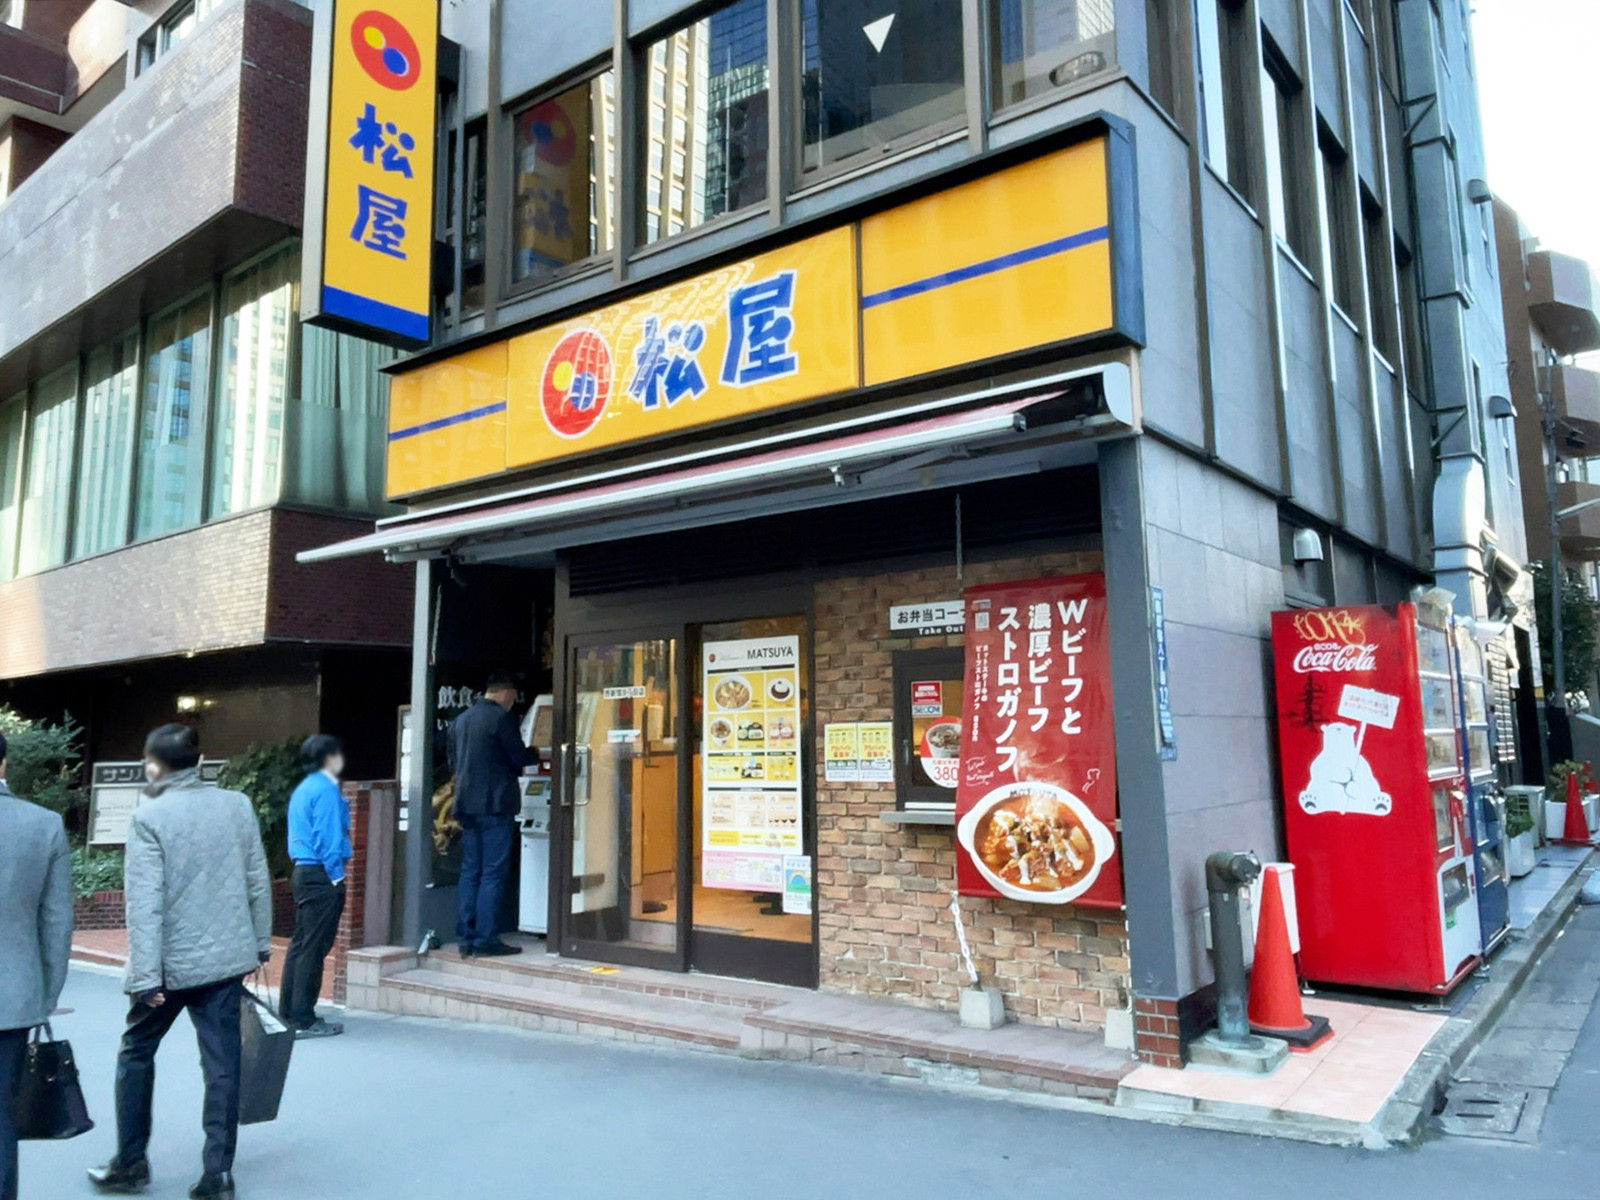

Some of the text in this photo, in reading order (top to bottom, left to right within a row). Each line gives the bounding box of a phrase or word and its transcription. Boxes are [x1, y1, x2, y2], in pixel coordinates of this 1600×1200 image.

[349, 102, 415, 260] 松屋
[627, 270, 798, 411] 松屋
[747, 646, 794, 659] MATSUYA
[918, 625, 964, 635] Take Out
[995, 607, 1022, 772] ストロガノフ
[1027, 602, 1052, 732] 濃厚ビーフ
[1057, 599, 1088, 734] Wビーフと
[1293, 643, 1379, 672] Coca-Cola
